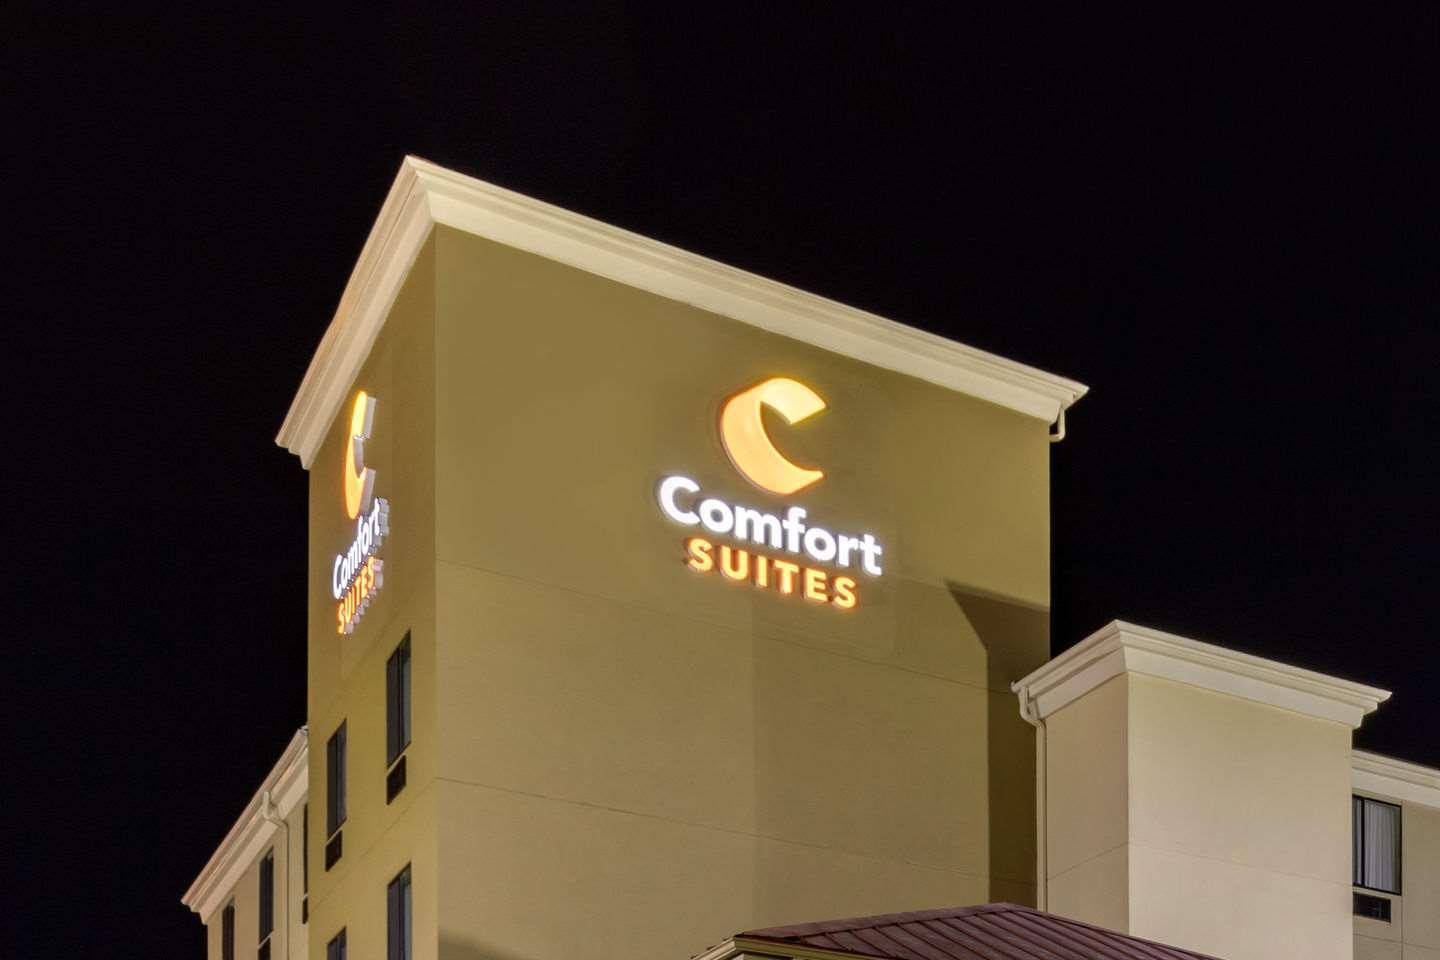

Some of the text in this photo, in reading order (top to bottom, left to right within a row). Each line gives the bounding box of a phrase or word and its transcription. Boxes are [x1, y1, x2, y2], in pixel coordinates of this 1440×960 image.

[333, 497, 382, 600] Comfort
[658, 475, 883, 576] Comfort
[337, 556, 377, 635] SUITES
[686, 537, 857, 609] SUITES
